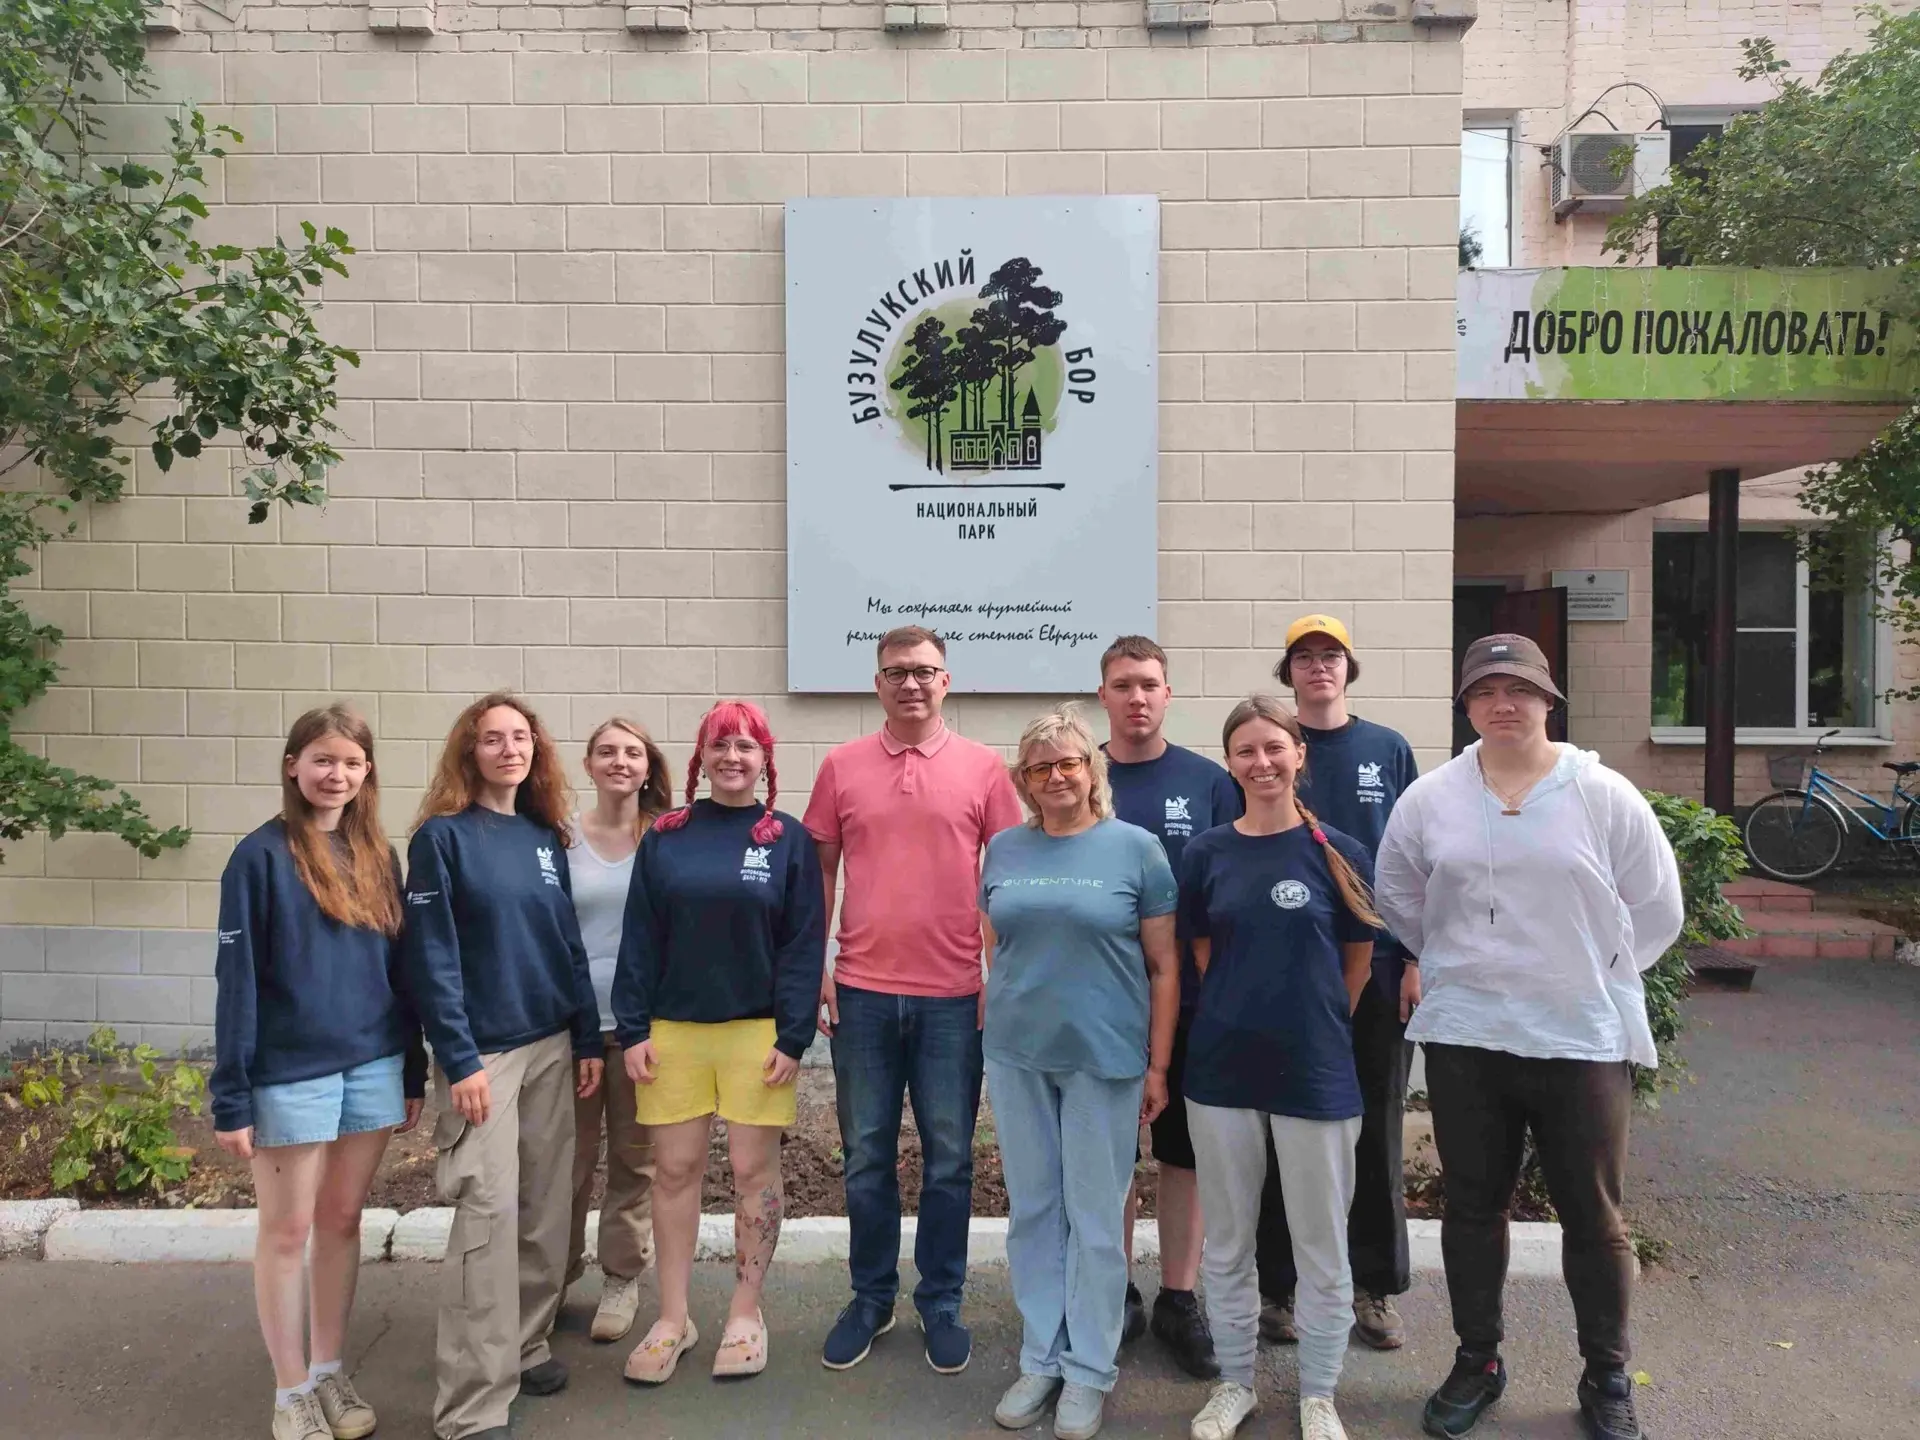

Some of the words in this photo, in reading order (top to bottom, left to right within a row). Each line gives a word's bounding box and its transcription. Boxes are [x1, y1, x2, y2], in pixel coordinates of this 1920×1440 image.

[847, 248, 975, 424] БУЗУЛУКСКИЙ
[1504, 310, 1623, 363] ДОБРО
[1633, 310, 1890, 357] ПОЖАЛОВАТЬ!
[1065, 347, 1096, 404] БОР
[916, 498, 1037, 519] НАЦИОНАЛЬНЫЙ
[958, 524, 995, 539] ПАРК
[867, 597, 893, 614] Мы
[898, 602, 972, 619] сохраняем
[978, 600, 1072, 619] крупнейший
[968, 624, 1034, 641] степной
[1039, 624, 1098, 648] Евразии
